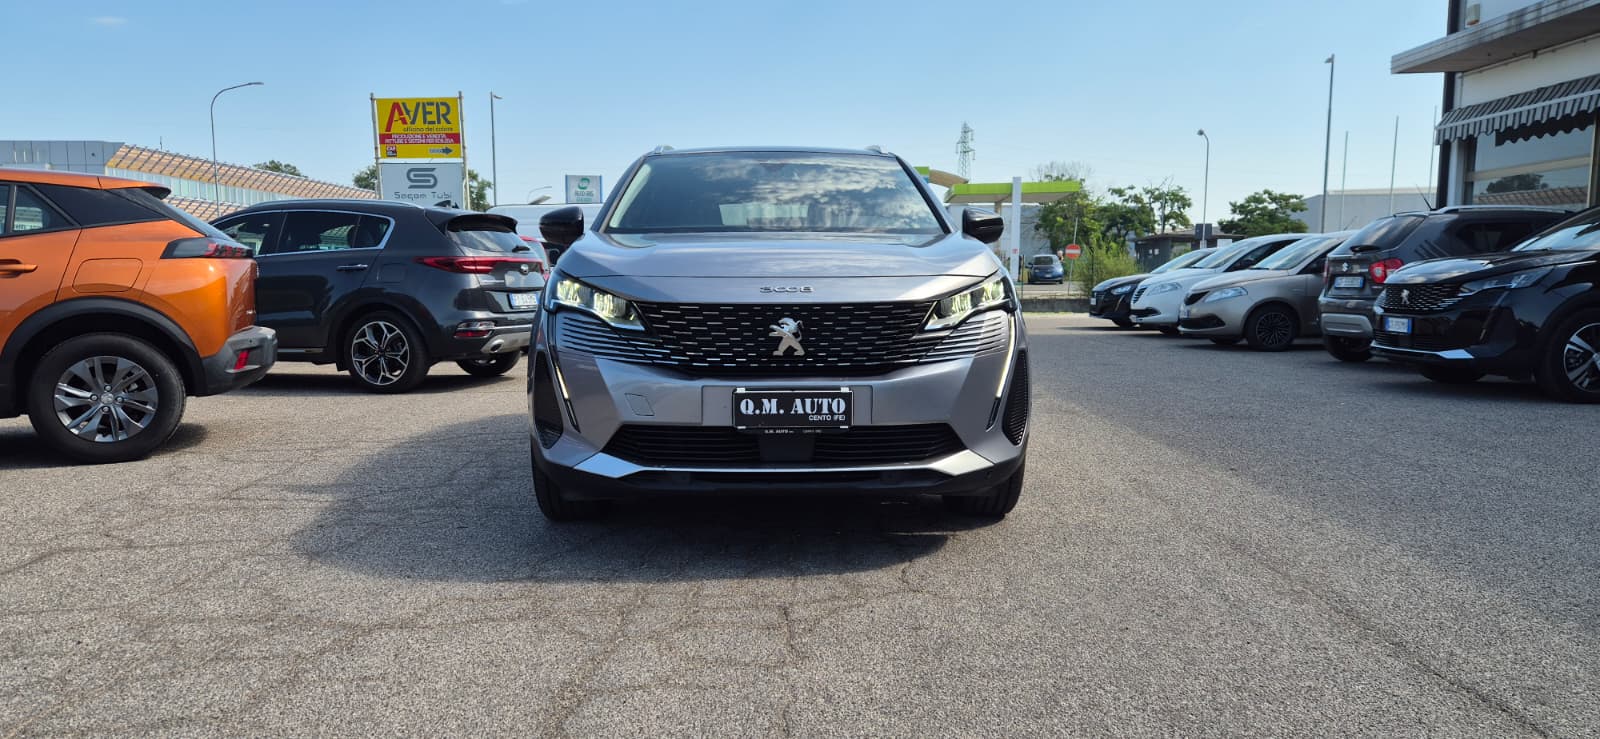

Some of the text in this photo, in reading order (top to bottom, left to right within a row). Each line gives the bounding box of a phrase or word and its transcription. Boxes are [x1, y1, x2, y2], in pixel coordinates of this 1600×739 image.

[385, 102, 452, 132] AVER
[740, 398, 846, 415] Q.M. AUTO
